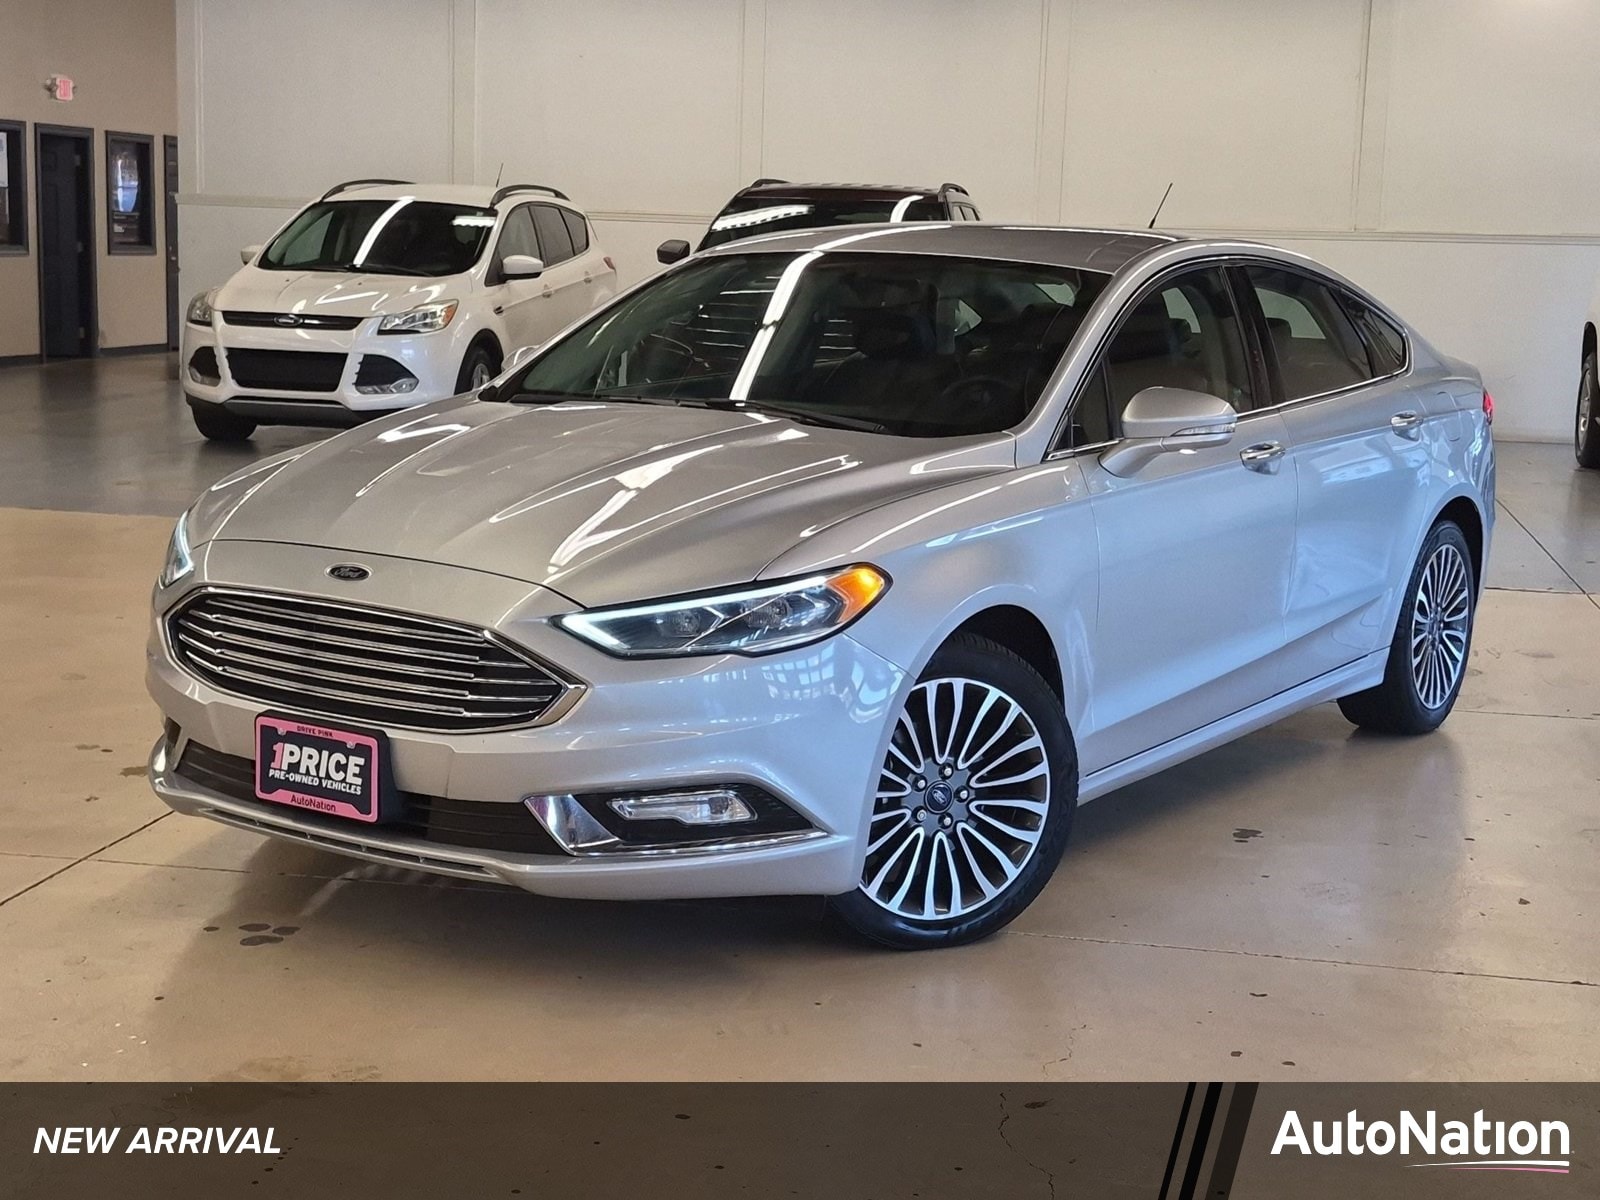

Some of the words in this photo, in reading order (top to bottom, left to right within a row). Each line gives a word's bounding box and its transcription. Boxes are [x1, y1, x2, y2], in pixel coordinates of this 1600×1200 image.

[296, 725, 317, 735] DRIVE
[317, 730, 334, 738] PINK
[268, 768, 320, 786] PRE-OWNED
[321, 778, 362, 796] VEHICLES
[290, 794, 336, 812] AutoNation
